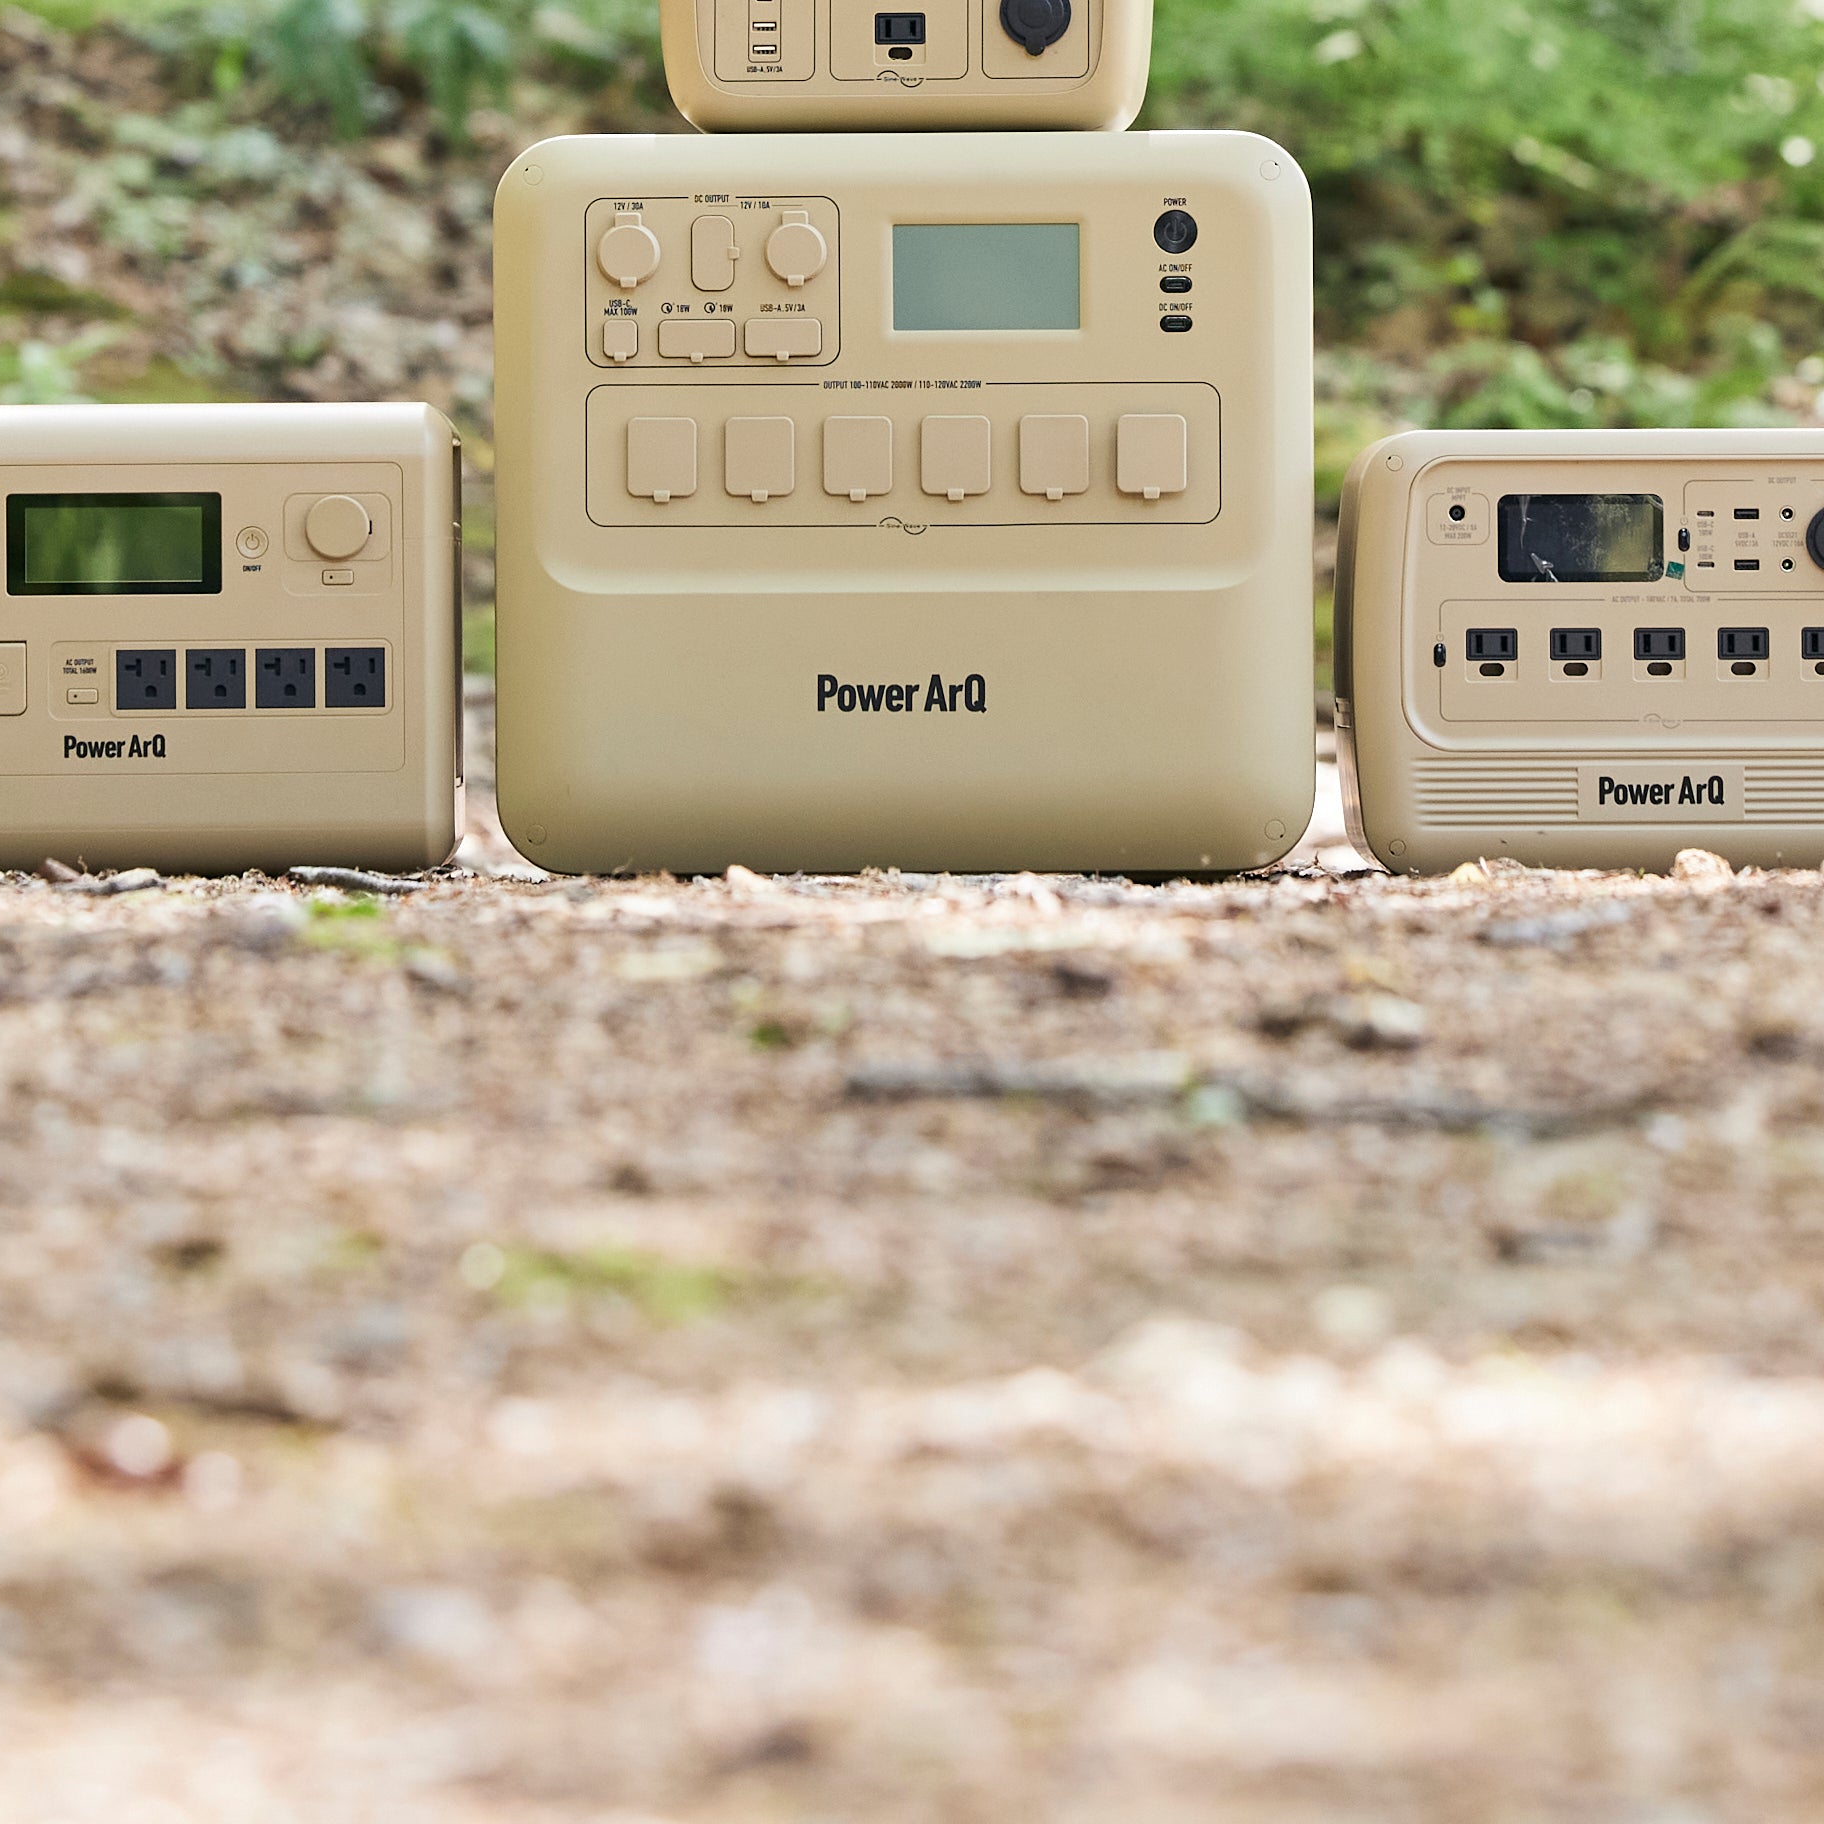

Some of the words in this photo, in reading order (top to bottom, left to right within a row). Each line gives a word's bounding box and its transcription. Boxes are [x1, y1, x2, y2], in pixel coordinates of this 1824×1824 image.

[694, 194, 703, 203] DC
[705, 194, 730, 203] OUTPUT
[1163, 197, 1187, 206] POWER
[613, 202, 626, 210] 12V
[631, 202, 643, 210] 30A
[740, 201, 753, 209] 12V
[758, 201, 771, 209] 10A
[1158, 264, 1167, 272] AC
[1168, 264, 1193, 272] ON/OFF
[604, 308, 619, 316] MAX
[620, 307, 638, 316] 100W
[785, 304, 806, 313] 5V/3A
[1158, 303, 1168, 311] DC
[1169, 303, 1193, 311] ON/OFF
[823, 380, 848, 389] OUTPUT
[850, 380, 889, 389] 100-110VAC
[919, 380, 958, 389] 110-120VAC
[960, 380, 982, 389] 2200W
[1776, 476, 1797, 484] OUTPUT
[1620, 595, 1640, 603] OUTPUT
[66, 658, 73, 666] AC
[74, 658, 94, 666] OUTPUT
[817, 674, 920, 712] Power
[923, 673, 987, 714] ArQ
[63, 735, 126, 758] Power
[128, 734, 167, 758] ArQ
[1598, 776, 1675, 805] Power
[1678, 775, 1725, 805] ArQ
